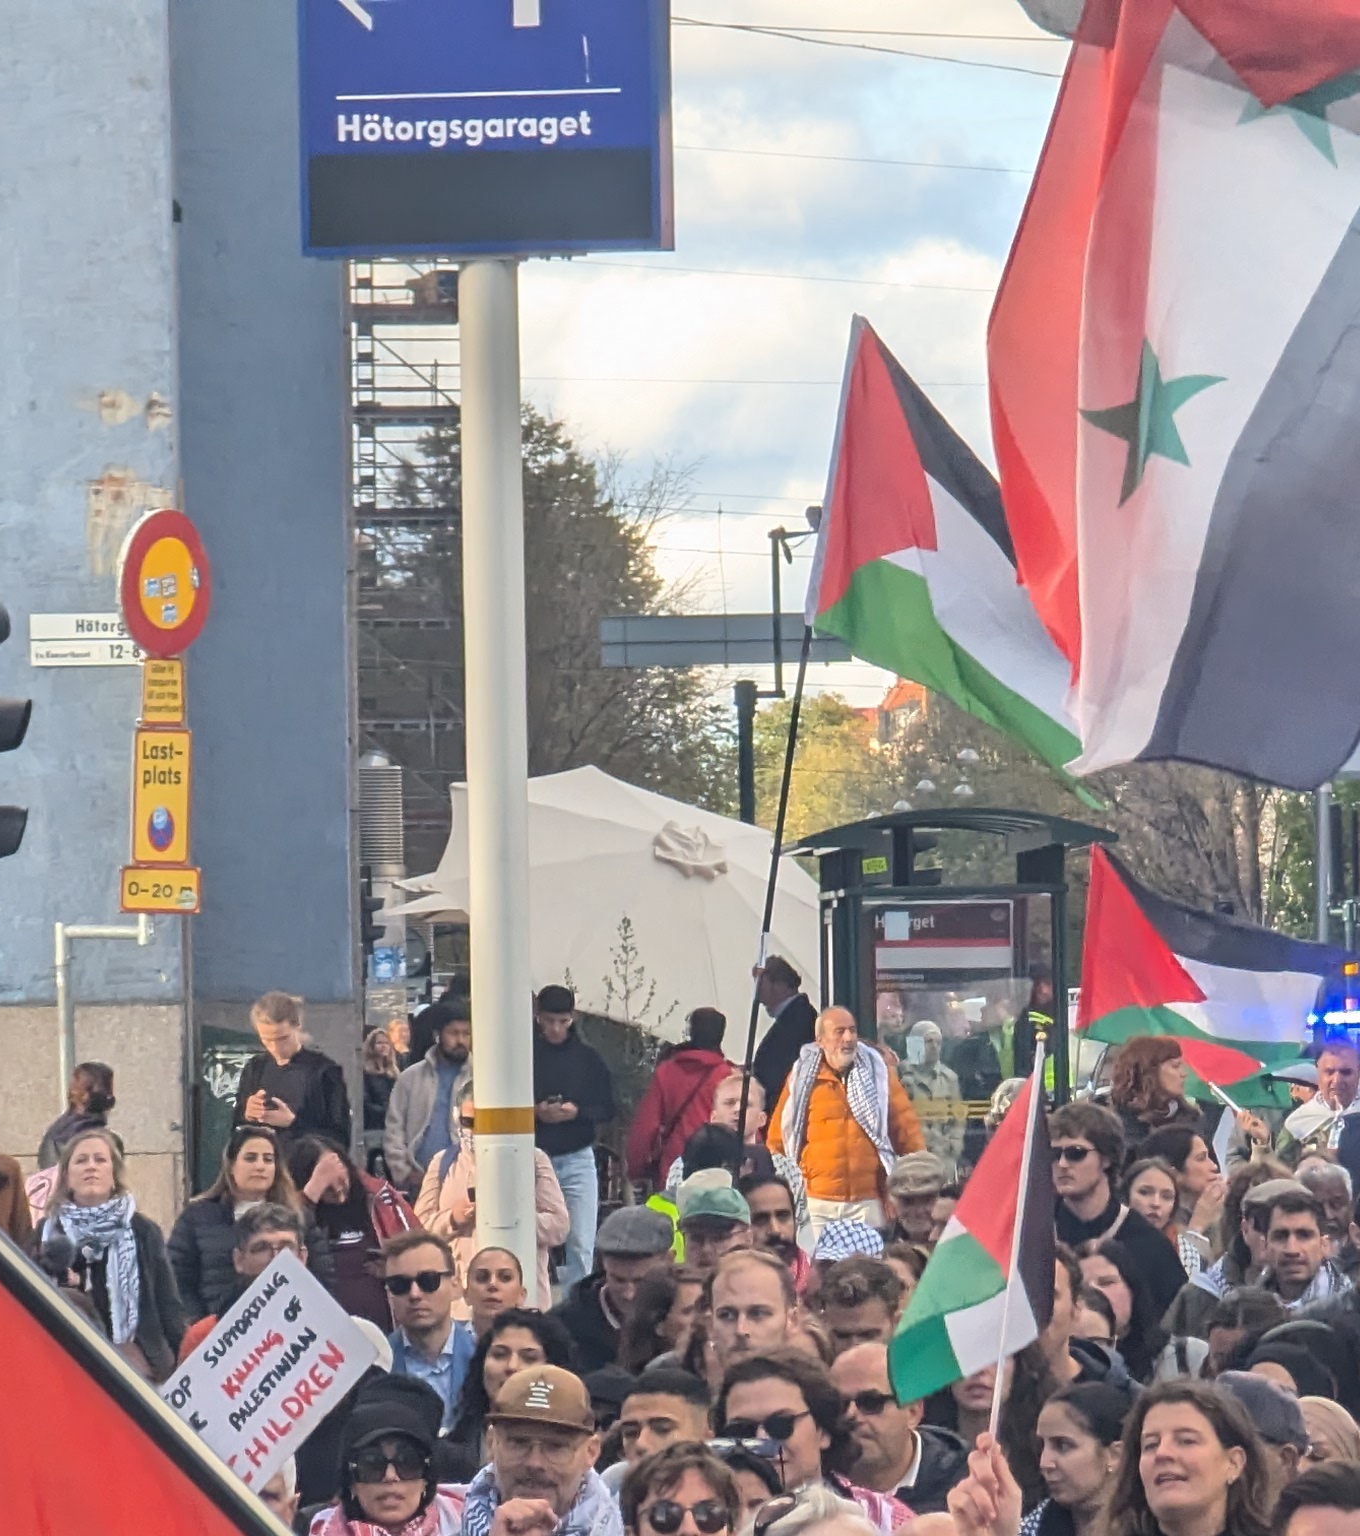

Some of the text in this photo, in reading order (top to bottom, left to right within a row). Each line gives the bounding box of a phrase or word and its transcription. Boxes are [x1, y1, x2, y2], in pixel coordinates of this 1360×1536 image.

[337, 110, 592, 147] Hötorgsgaraget
[75, 619, 126, 635] Hötorg
[142, 740, 183, 761] Last-
[143, 765, 182, 788] plats
[128, 881, 173, 898] 0-20
[874, 914, 936, 931] Hrget
[220, 1295, 305, 1400] KILLING OF
[228, 1327, 318, 1432] PALESTINIAN
[164, 1374, 192, 1409] OP
